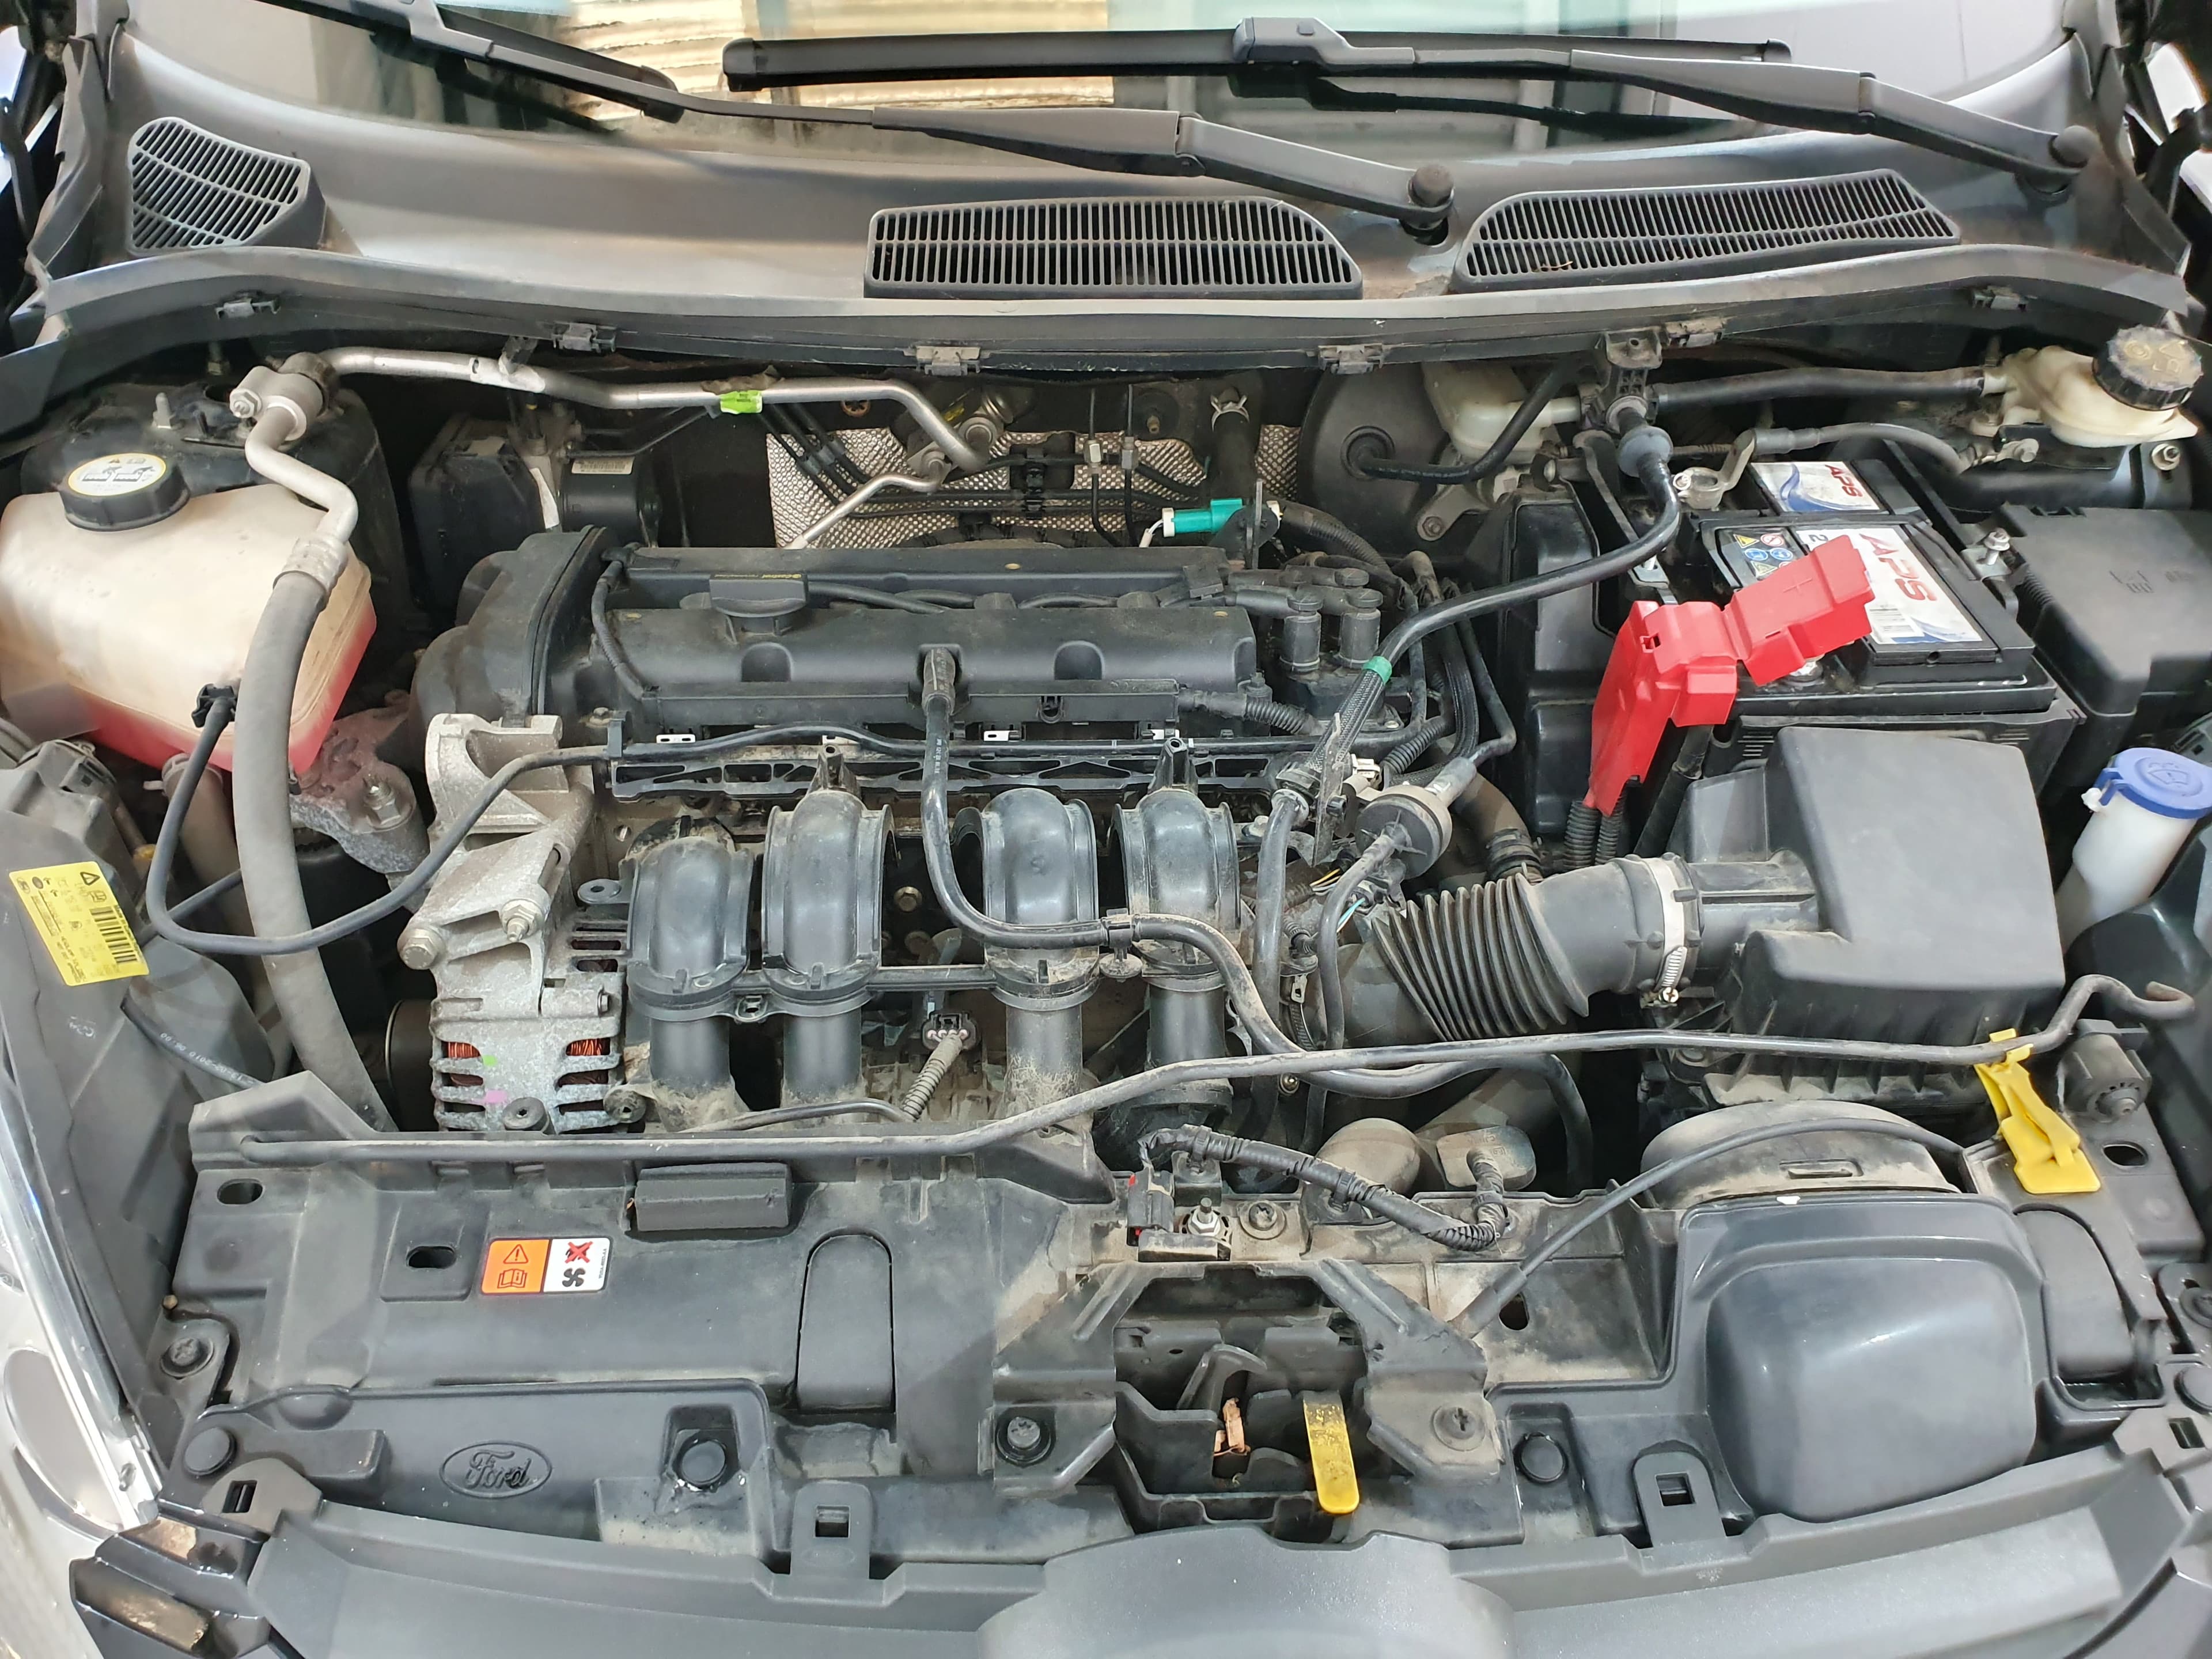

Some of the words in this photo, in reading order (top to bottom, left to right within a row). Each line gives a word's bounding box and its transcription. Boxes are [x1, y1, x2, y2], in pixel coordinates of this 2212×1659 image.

[1824, 464, 1862, 497] APS
[1859, 533, 1937, 601] APS
[465, 1450, 532, 1488] Ford
